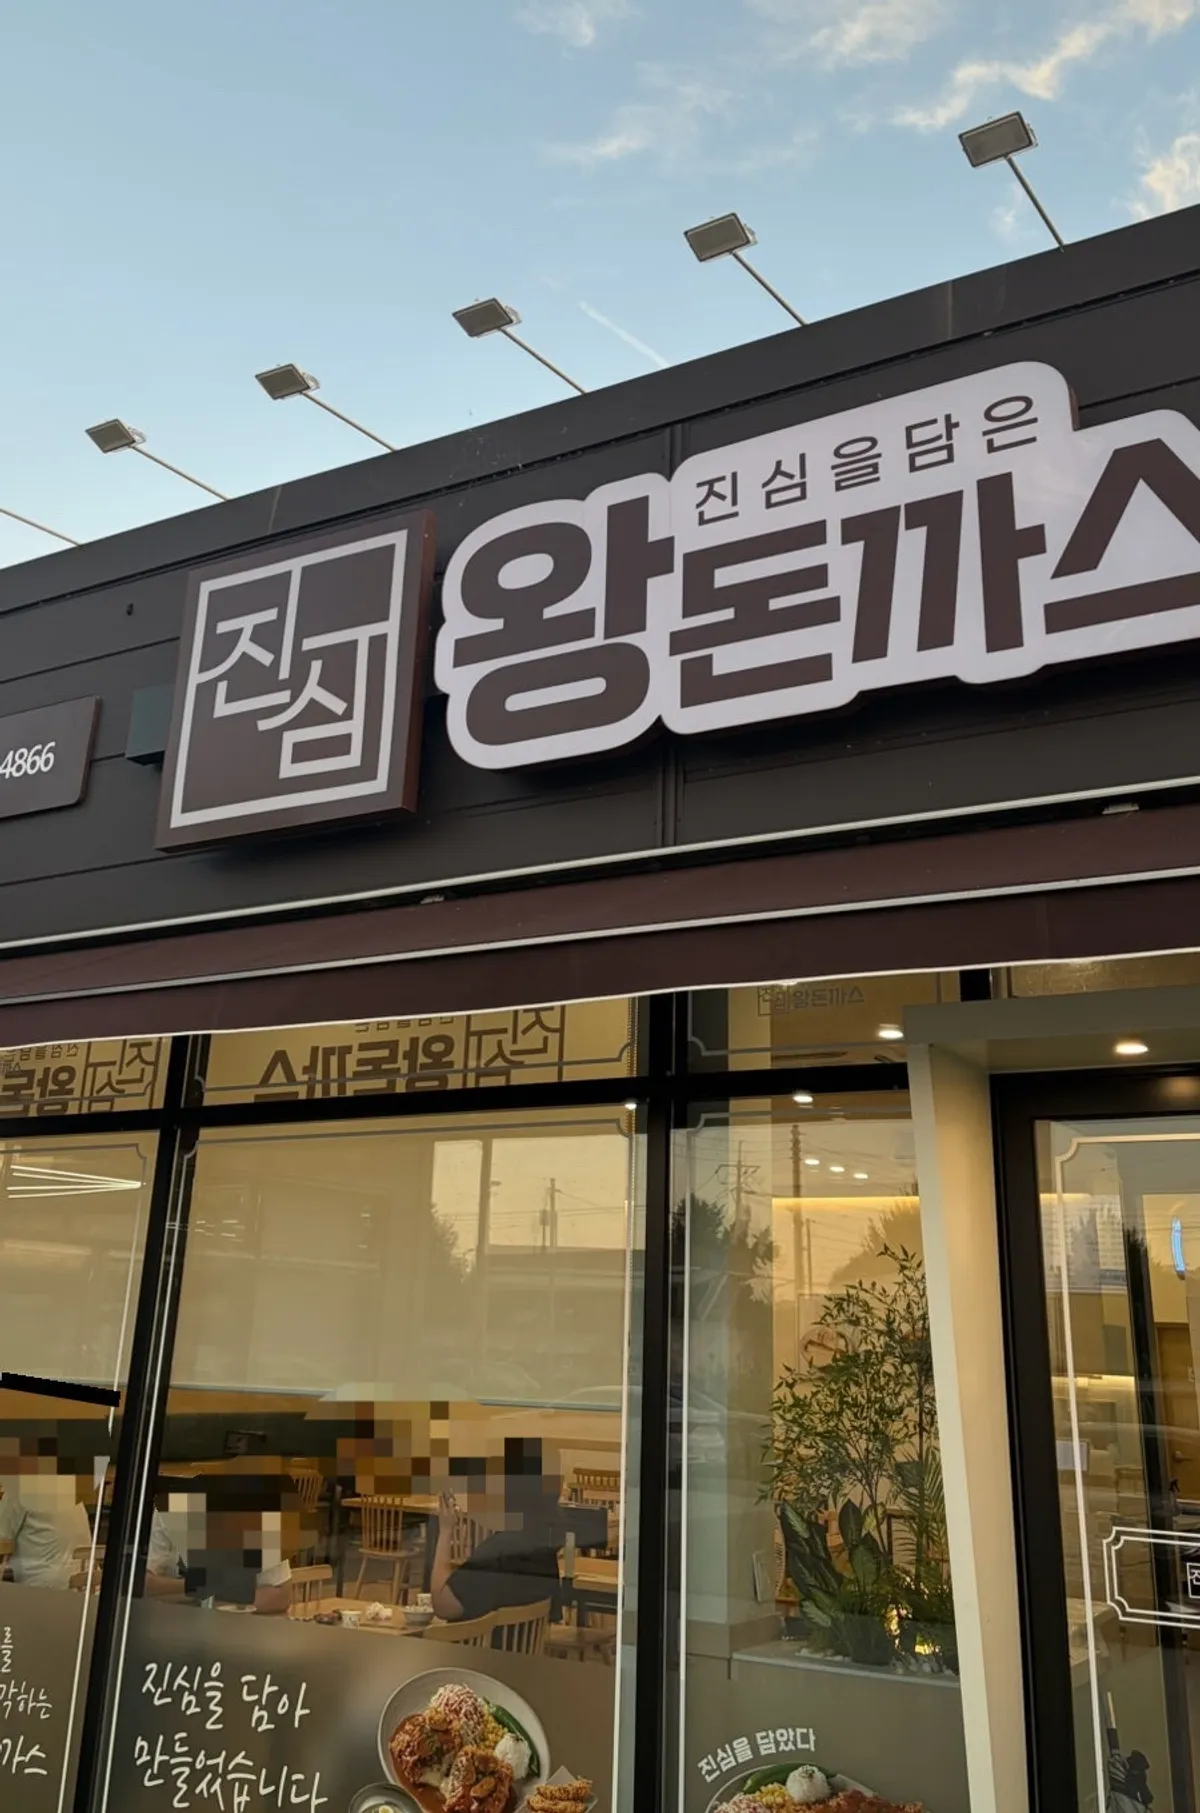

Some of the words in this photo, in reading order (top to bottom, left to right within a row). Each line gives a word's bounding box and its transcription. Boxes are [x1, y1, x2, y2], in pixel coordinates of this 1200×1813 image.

[452, 438, 1200, 745] 왕돈까스
[196, 565, 392, 780] 진심
[141, 1661, 225, 1730] 진심을
[240, 1674, 311, 1733] 담아
[134, 1732, 329, 1813] 만들었습니다
[697, 1736, 754, 1783] 진심을
[755, 1728, 816, 1756] 담았다
